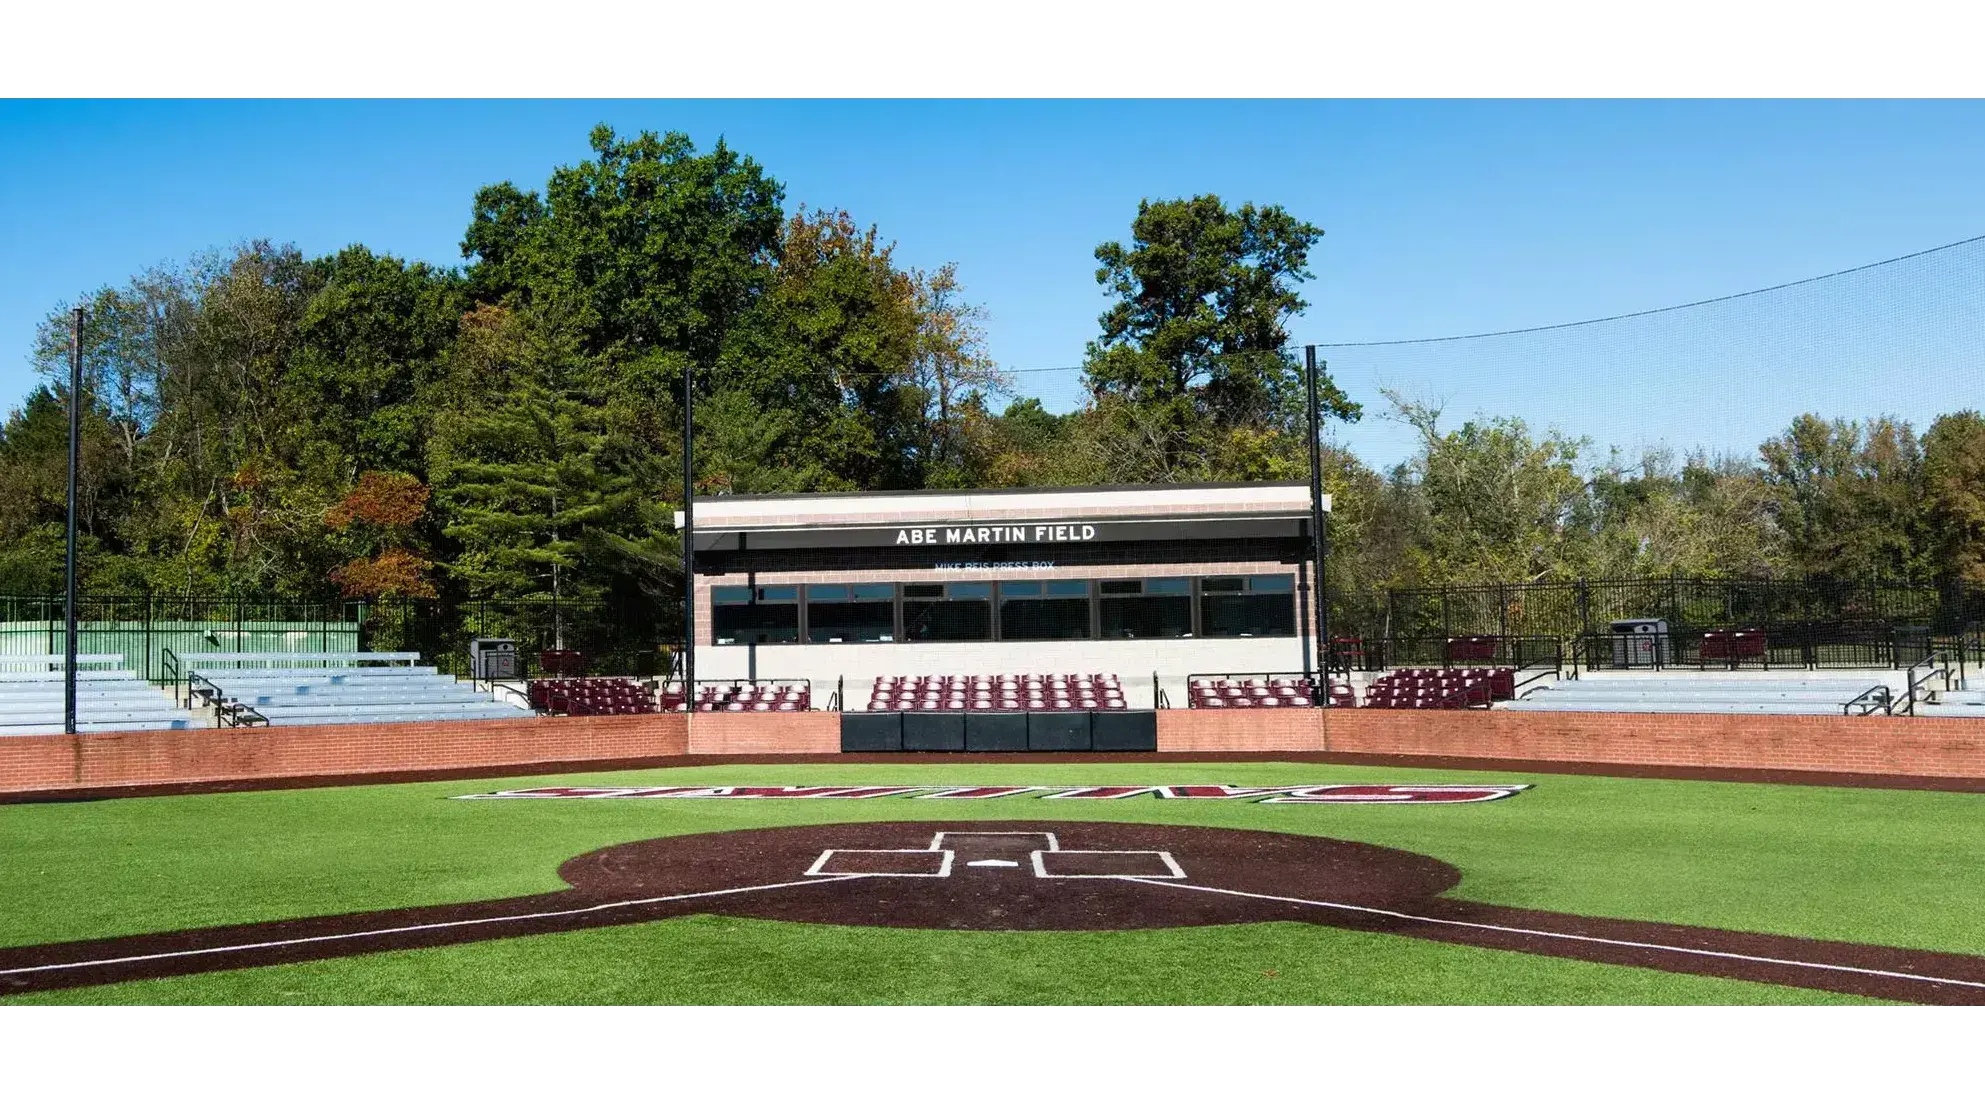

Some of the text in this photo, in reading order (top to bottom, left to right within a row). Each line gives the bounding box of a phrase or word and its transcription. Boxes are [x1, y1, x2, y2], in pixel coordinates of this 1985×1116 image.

[896, 525, 1095, 545] ABE MARTIN FIELD
[934, 561, 1055, 573] MIKE REIS PRESS BOX
